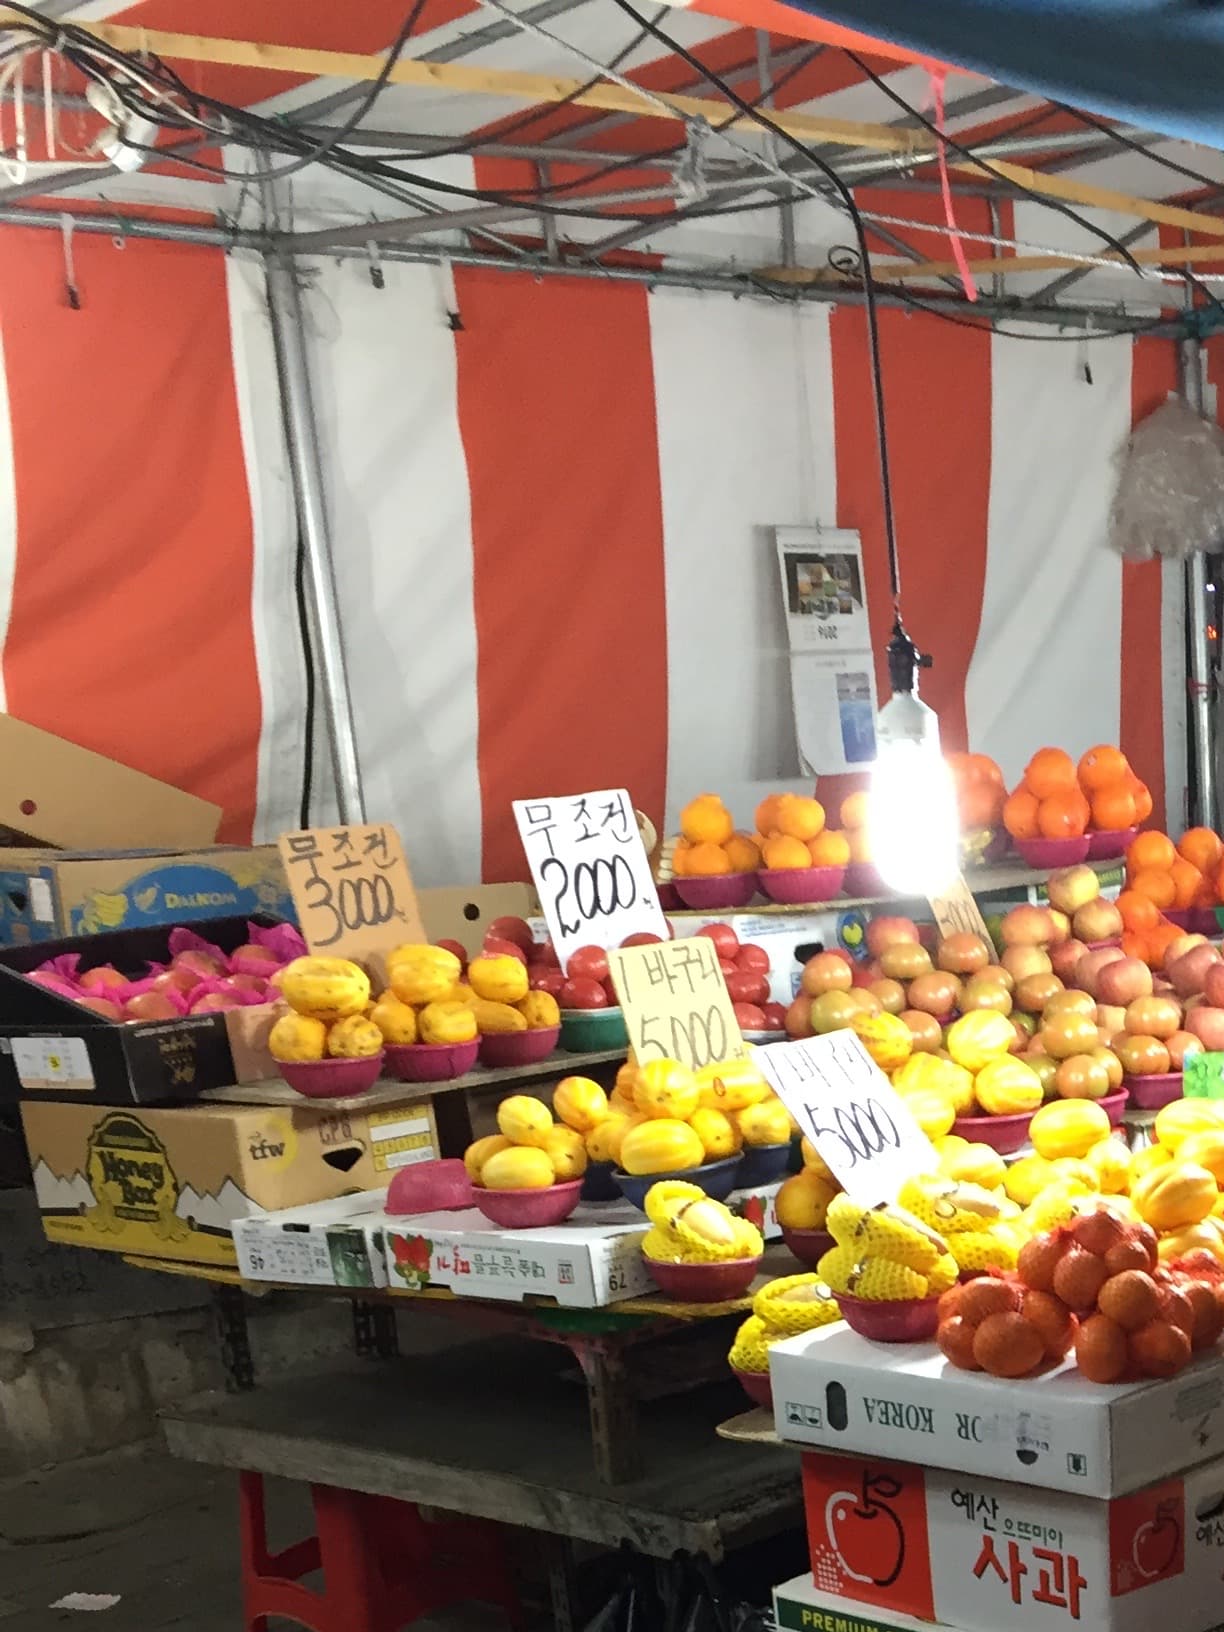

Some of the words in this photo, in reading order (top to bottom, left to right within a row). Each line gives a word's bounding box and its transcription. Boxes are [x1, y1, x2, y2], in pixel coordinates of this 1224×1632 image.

[304, 873, 396, 947] 3000
[540, 854, 636, 938] 2000
[863, 1396, 935, 1434] KOREA
[951, 1487, 1000, 1532] 예산
[972, 1534, 1088, 1620] 사과
